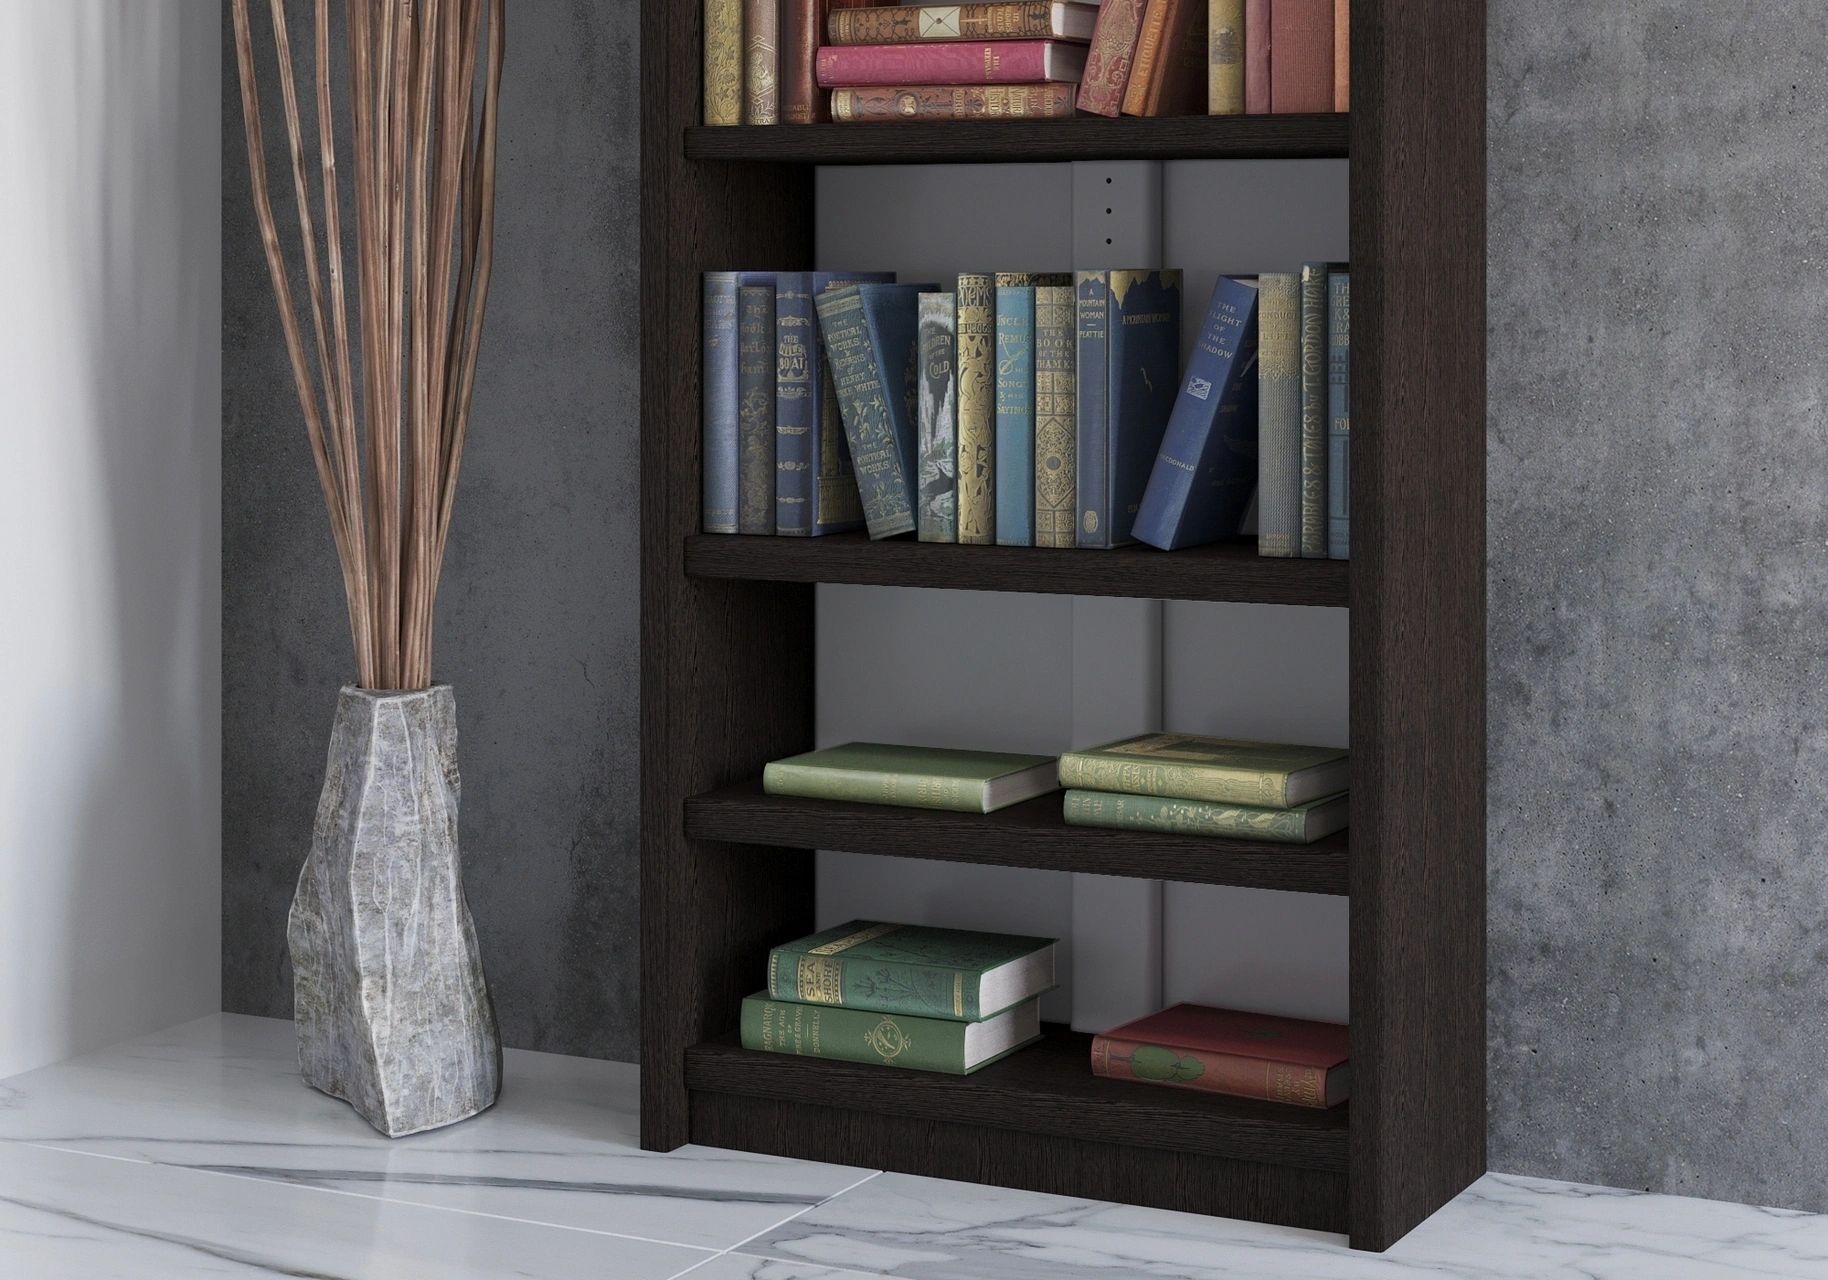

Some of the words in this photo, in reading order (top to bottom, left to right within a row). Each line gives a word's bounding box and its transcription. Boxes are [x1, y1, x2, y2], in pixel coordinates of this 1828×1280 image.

[1139, 11, 1161, 75] ETIQUETTE
[992, 55, 1000, 70] THE
[1088, 288, 1094, 296] A
[1079, 299, 1105, 308] MOUNTAIN
[1216, 301, 1237, 314] THE
[1079, 311, 1105, 320] WOMAN
[832, 319, 849, 327] THE
[1213, 324, 1226, 332] OF
[783, 335, 799, 344] THE
[1043, 329, 1064, 337] THE
[1079, 330, 1105, 339] PEATTIE
[1208, 332, 1226, 345] THE
[830, 337, 860, 352] WORKS
[1303, 312, 1321, 376] GORDON
[1050, 350, 1070, 358] THE
[778, 357, 806, 370] BOAT
[929, 360, 950, 380] COLD
[840, 372, 865, 386] HENRY
[854, 379, 880, 392] WHITE
[860, 460, 890, 475] WORKS
[1304, 463, 1320, 477] &
[806, 962, 815, 997] SEA
[823, 960, 832, 1002] SHORE
